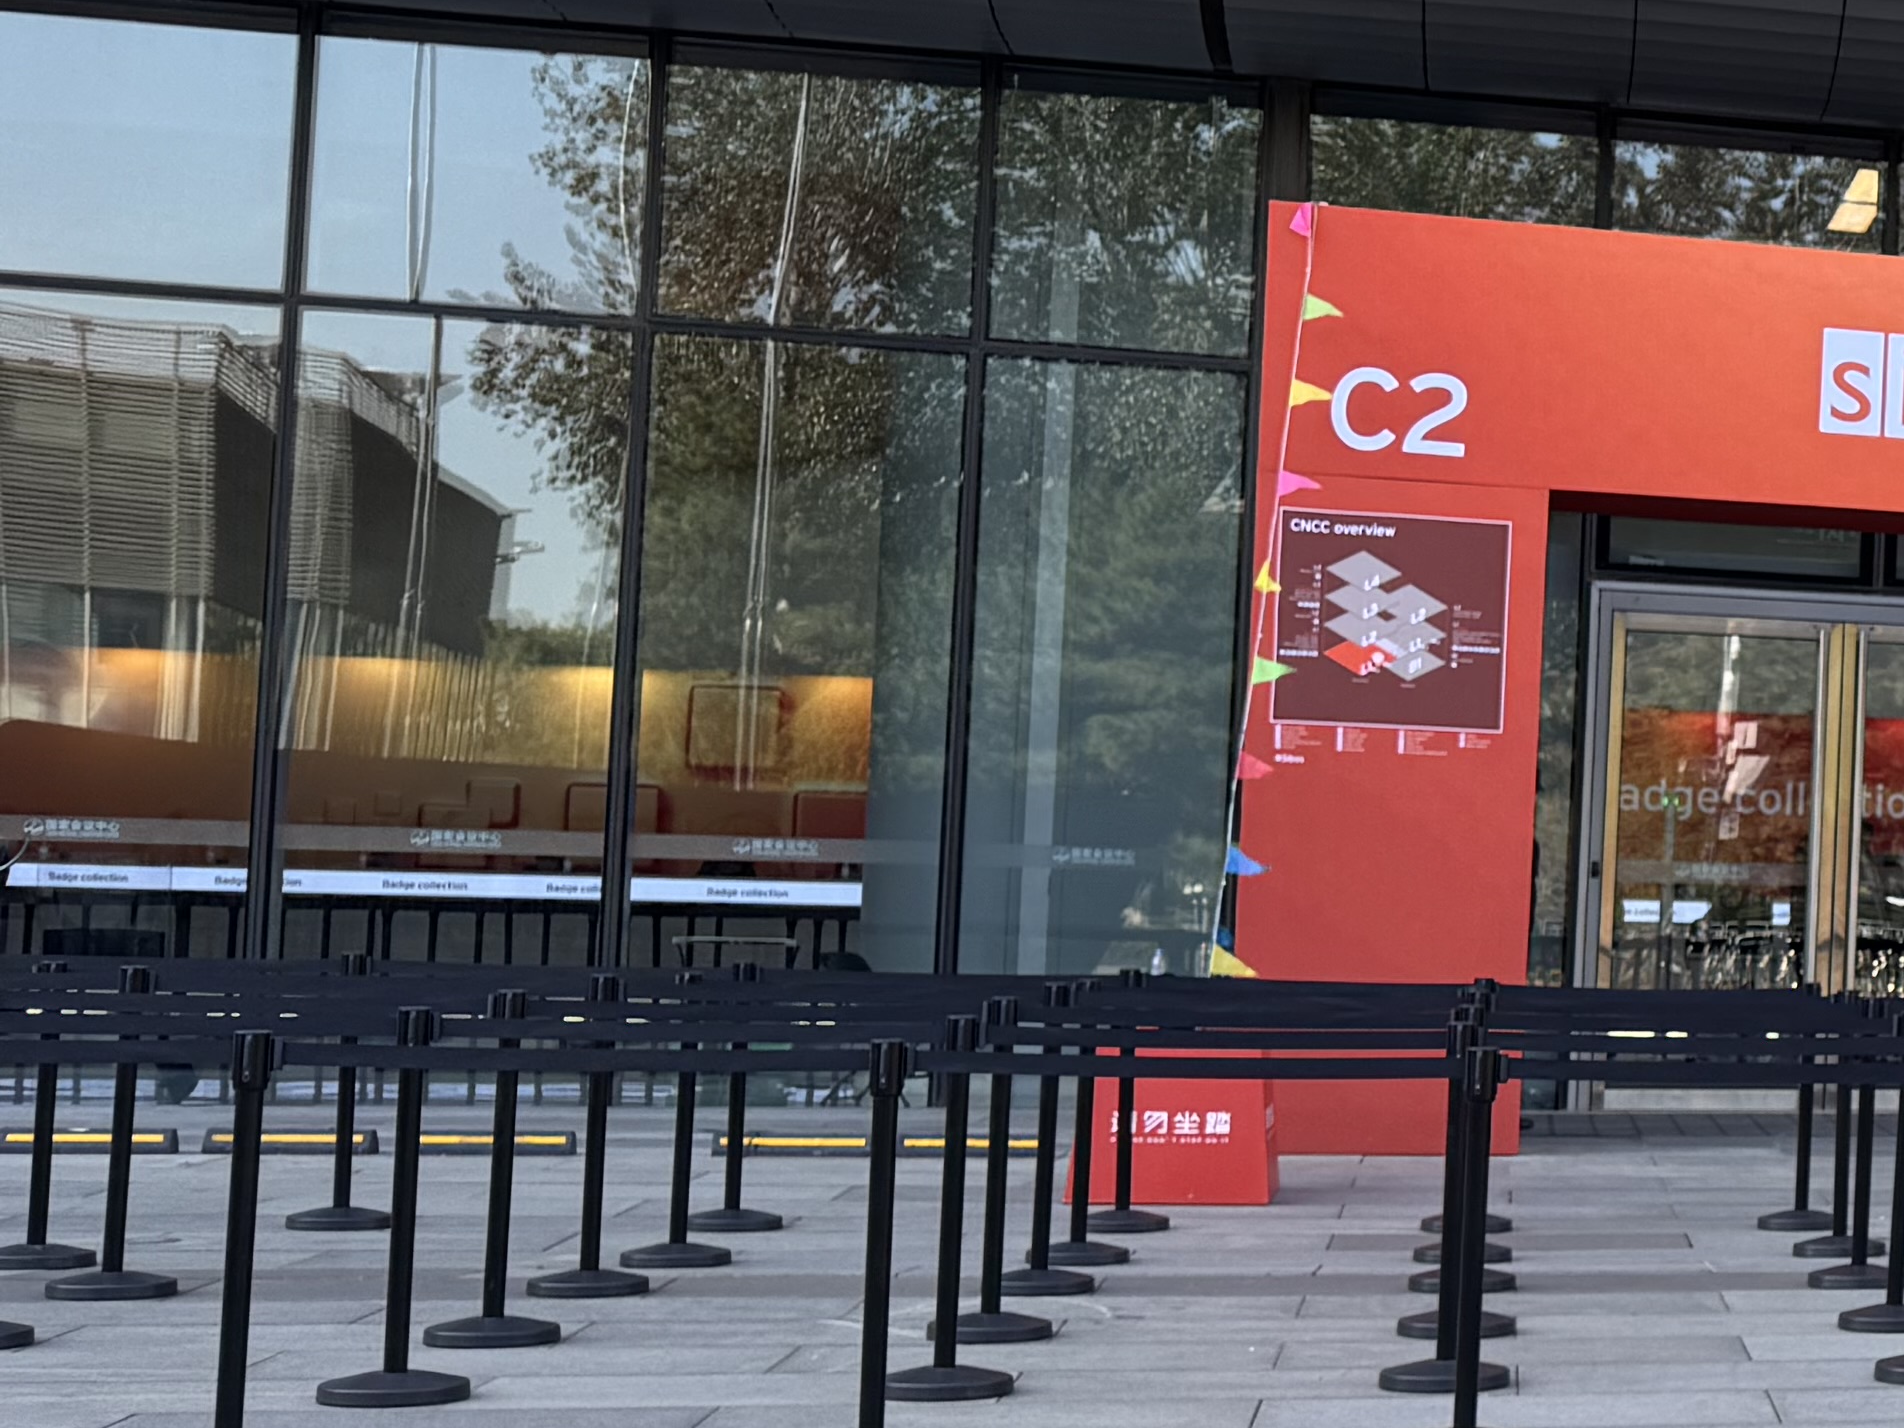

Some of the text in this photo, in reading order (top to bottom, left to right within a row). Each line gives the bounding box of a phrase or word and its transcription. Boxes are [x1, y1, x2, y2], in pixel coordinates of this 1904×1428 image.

[1330, 366, 1467, 458] C2
[1290, 518, 1396, 538] CNCC overview
[1620, 780, 1720, 820] adge
